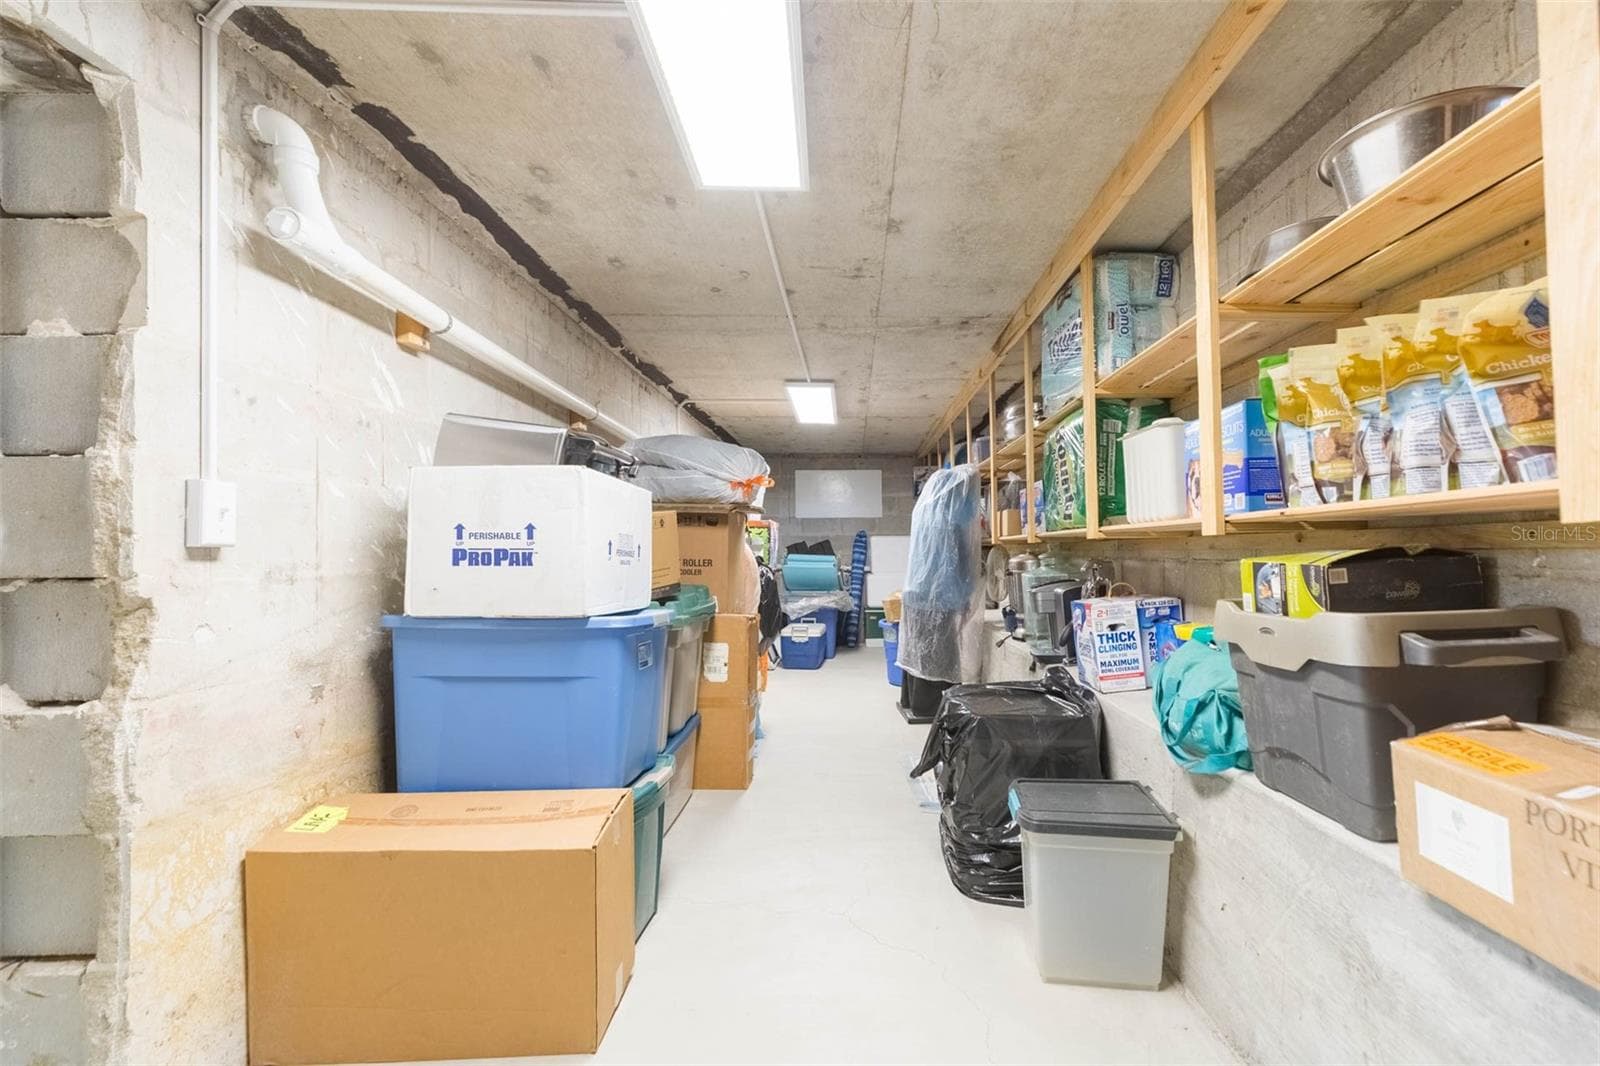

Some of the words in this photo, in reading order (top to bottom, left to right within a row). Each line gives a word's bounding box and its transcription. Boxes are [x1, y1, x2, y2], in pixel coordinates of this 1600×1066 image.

[1116, 302, 1130, 337] owel
[1486, 354, 1551, 374] Chicke
[468, 532, 521, 540] PERISHABLE
[682, 558, 713, 568] ROLLER
[1096, 630, 1137, 645] THICK
[1098, 642, 1138, 654] CLINGING
[1100, 658, 1140, 668] MAXIMUM
[1424, 735, 1531, 773] FRAGILE
